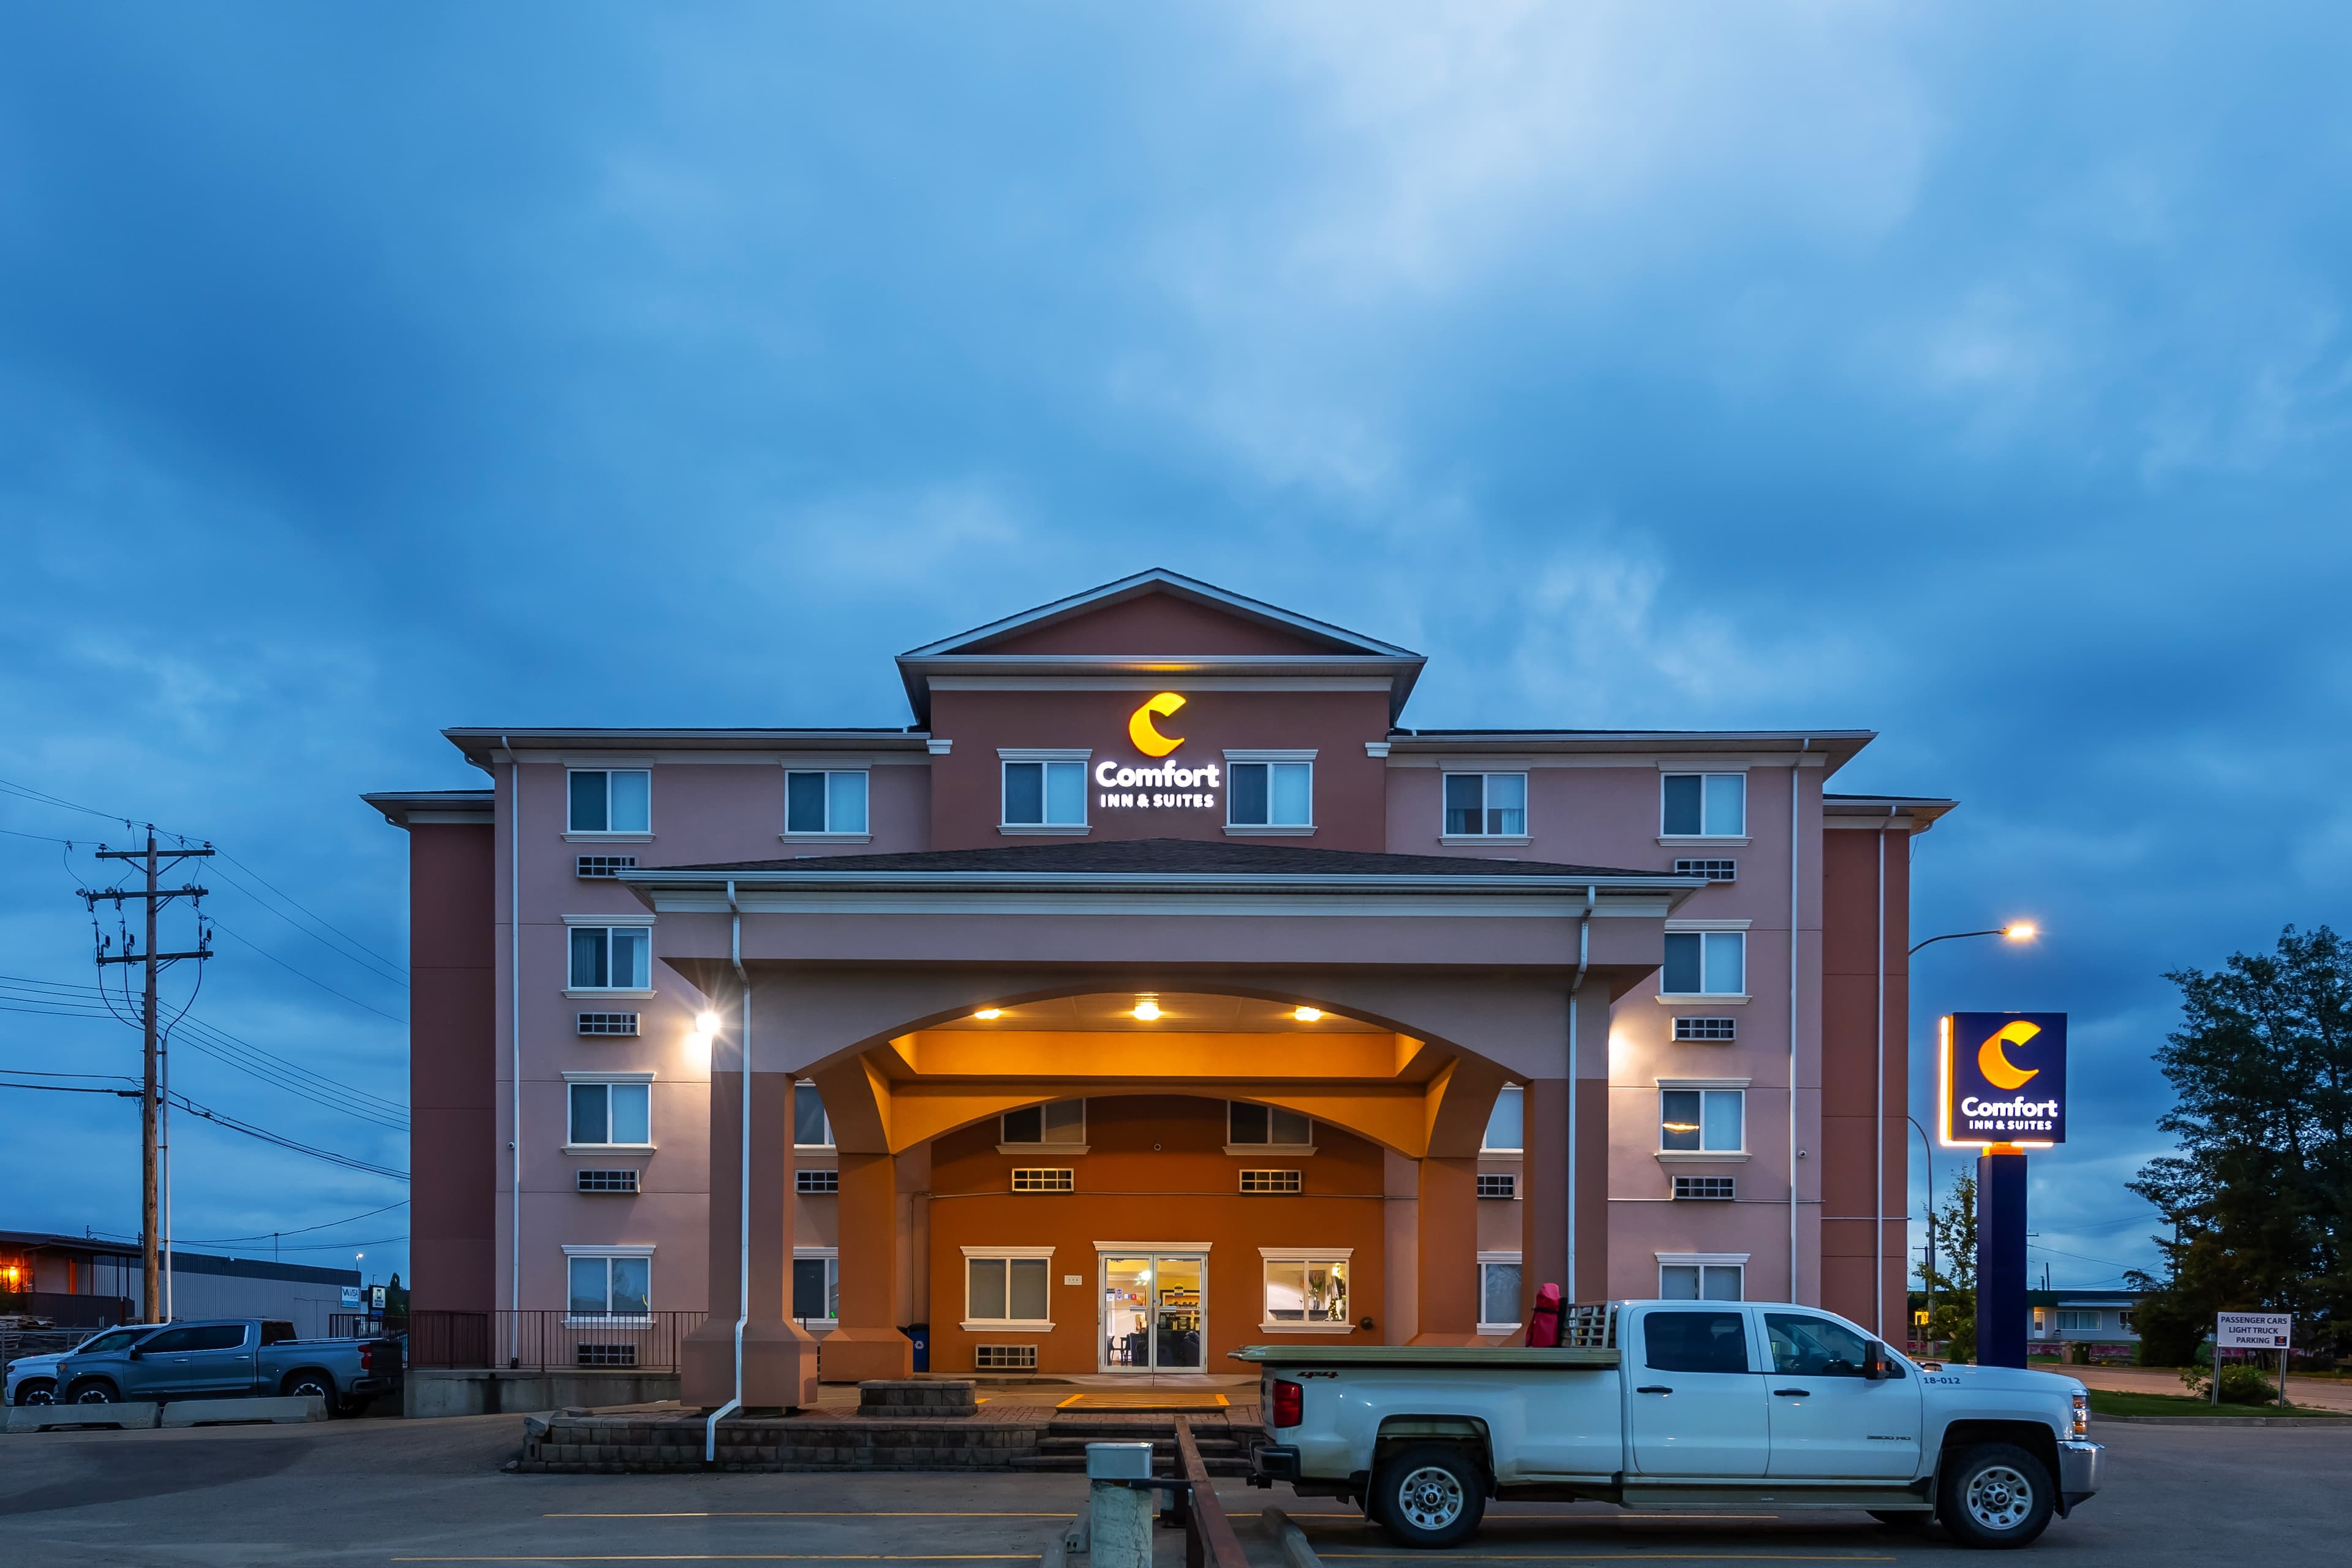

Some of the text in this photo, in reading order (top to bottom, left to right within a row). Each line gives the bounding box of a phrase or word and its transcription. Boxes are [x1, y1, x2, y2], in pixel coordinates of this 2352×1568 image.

[1095, 760, 1220, 788] Comfort
[1101, 794, 1215, 808] INN & SUITES
[1961, 1096, 2058, 1117] Comfort
[1969, 1120, 2052, 1130] INN & SUITES
